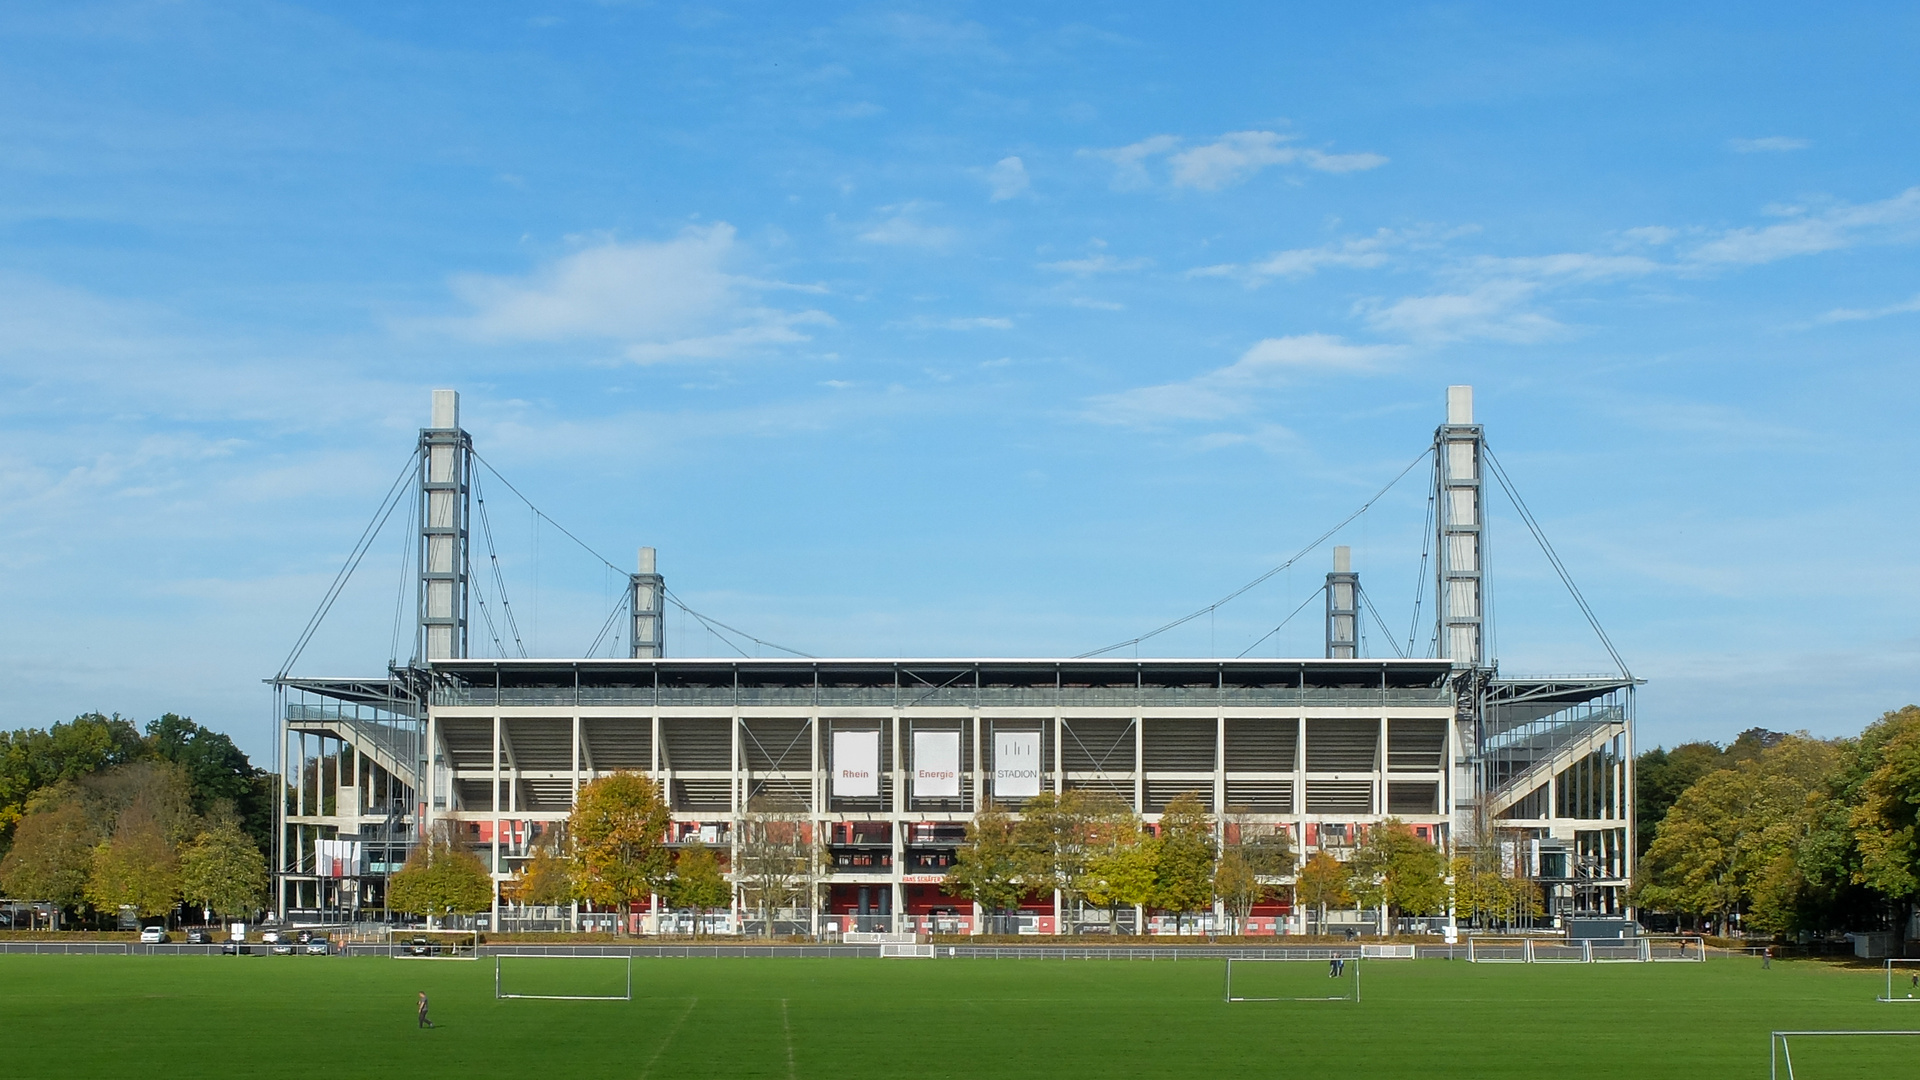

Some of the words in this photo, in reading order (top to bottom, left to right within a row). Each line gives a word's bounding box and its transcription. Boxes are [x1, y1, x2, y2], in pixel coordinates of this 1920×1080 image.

[842, 769, 869, 778] Rhein
[919, 769, 954, 780] Energie
[997, 769, 1037, 779] STADION
